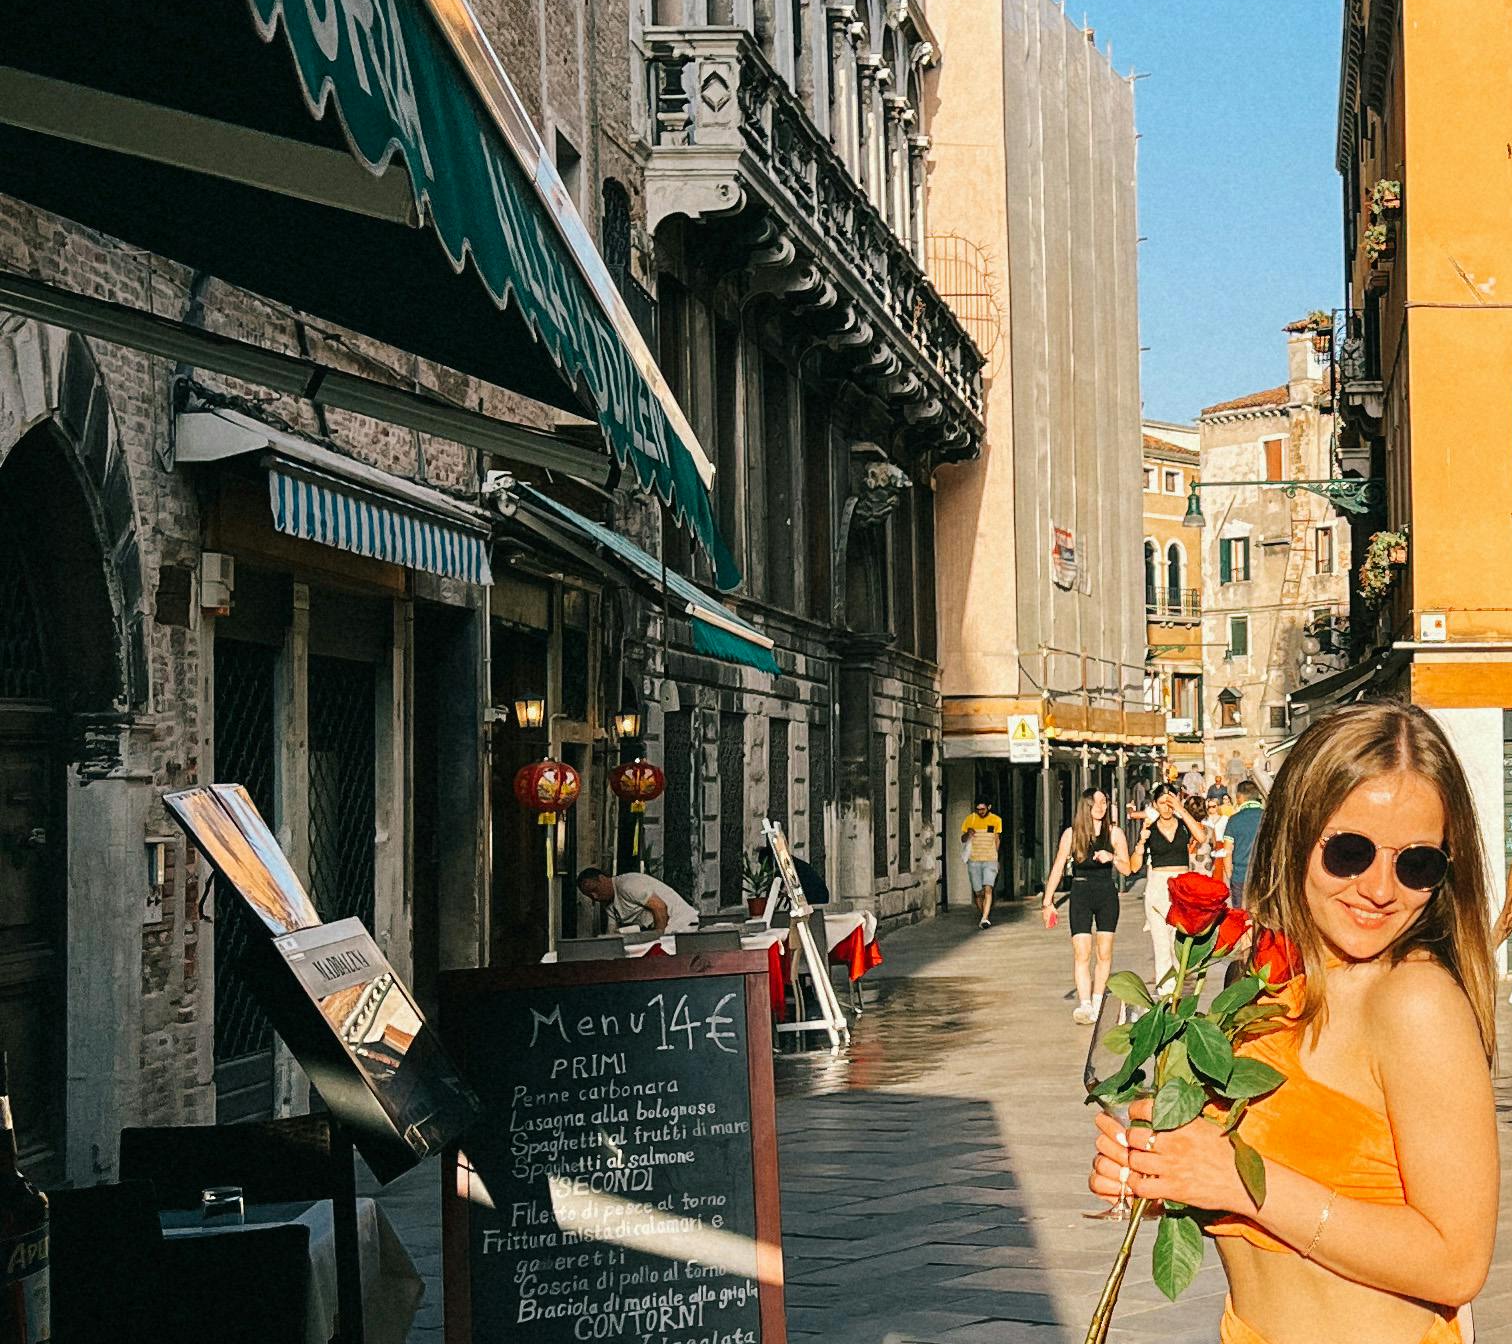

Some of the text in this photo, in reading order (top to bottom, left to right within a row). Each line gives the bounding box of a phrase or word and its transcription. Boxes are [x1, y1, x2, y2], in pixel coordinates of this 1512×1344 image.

[529, 993, 738, 1053] Menu 14€
[550, 1053, 627, 1079] PRIMI
[511, 1078, 679, 1108] Penne carbonara
[510, 1110, 586, 1137] Lasagna
[591, 1103, 629, 1124] alla
[510, 1131, 602, 1163] Spaghetti
[633, 1124, 687, 1145] frutti
[692, 1118, 707, 1136] di
[711, 1121, 750, 1136] mare
[511, 1146, 696, 1184] Spaghetti al salmone
[556, 1167, 653, 1198] SECONDI
[582, 1199, 599, 1219] di
[603, 1202, 653, 1224] pesce
[657, 1194, 675, 1211] al
[482, 1213, 725, 1254] Frittura mista di calamari e
[520, 1274, 590, 1298] Coscia
[596, 1268, 614, 1290] di
[619, 1265, 659, 1295] pollo
[663, 1260, 680, 1282] al
[517, 1295, 599, 1324] Braciola
[603, 1292, 620, 1313] di
[624, 1288, 684, 1311] maiale
[574, 1301, 704, 1340] CONTORNI
